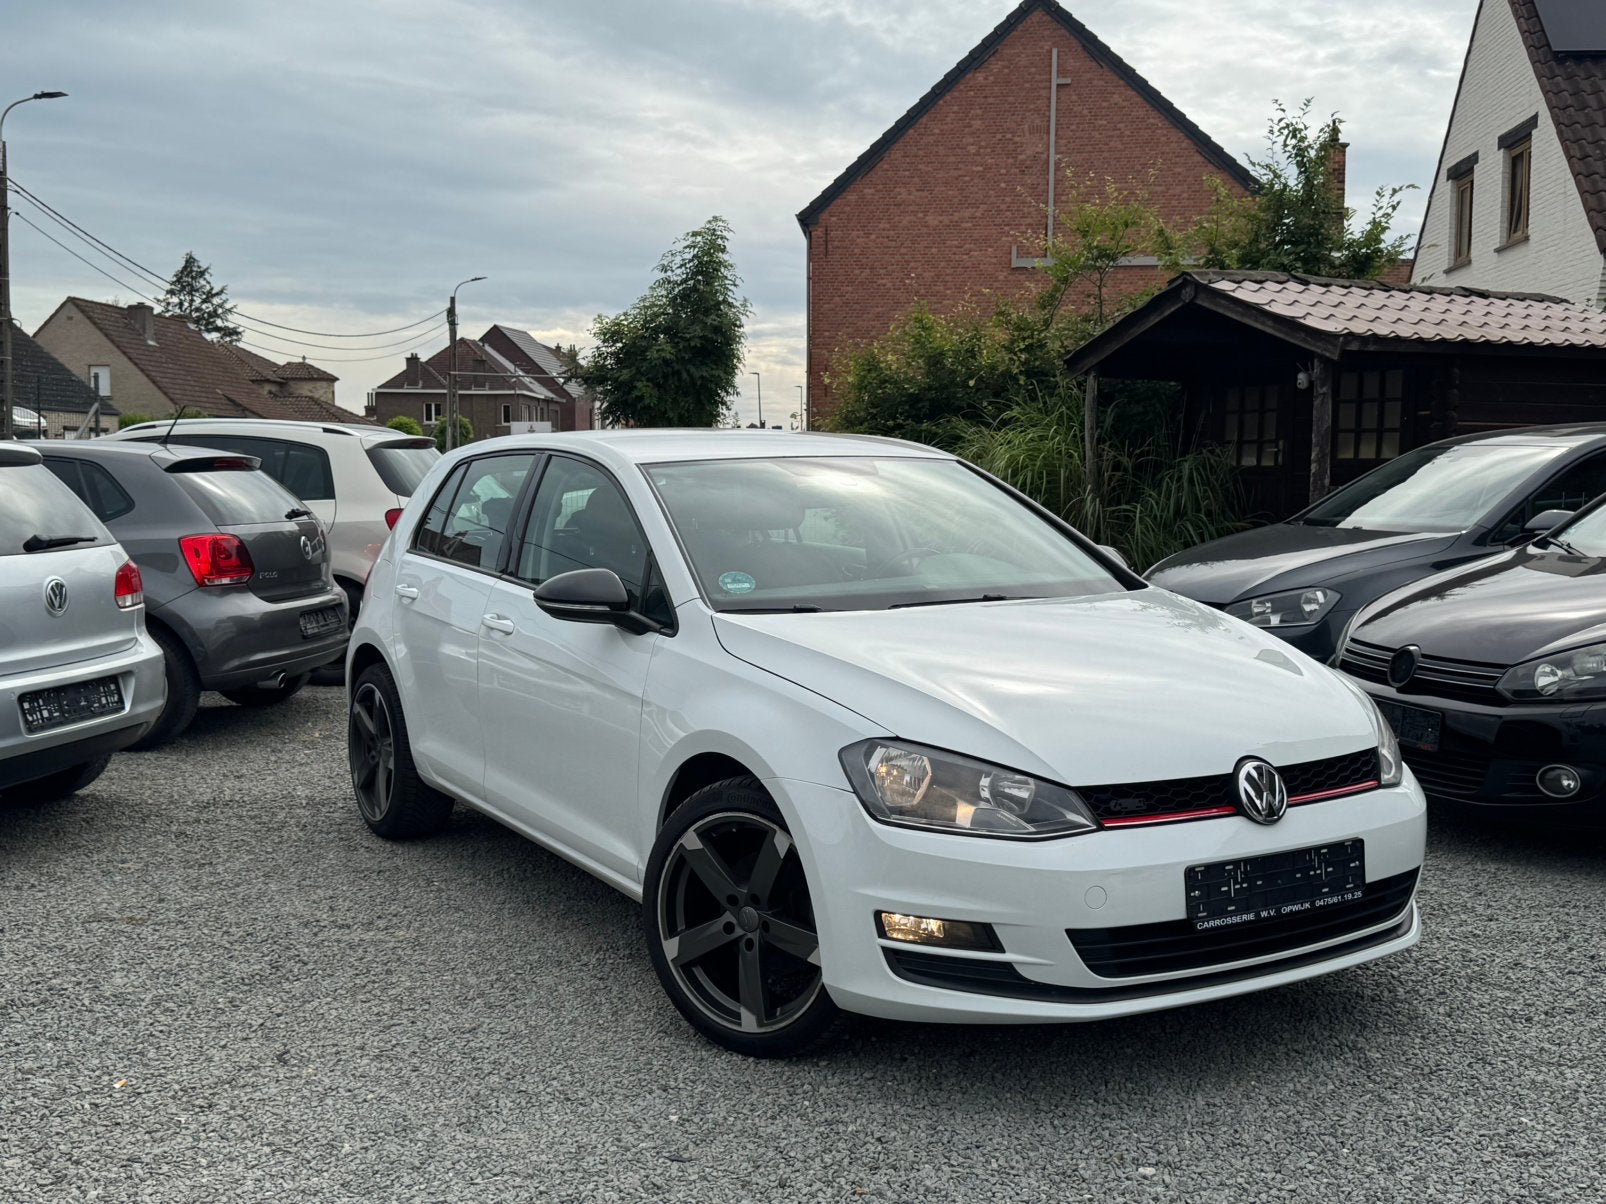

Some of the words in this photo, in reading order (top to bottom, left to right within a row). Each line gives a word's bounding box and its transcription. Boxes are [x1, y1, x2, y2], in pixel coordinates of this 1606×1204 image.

[1238, 761, 1287, 822] VW
[1197, 912, 1256, 930] CARROSSERIE
[1260, 908, 1277, 918] W.V.
[1281, 901, 1311, 914] OPWIJK
[1315, 890, 1363, 907] 0475/61.19.25
